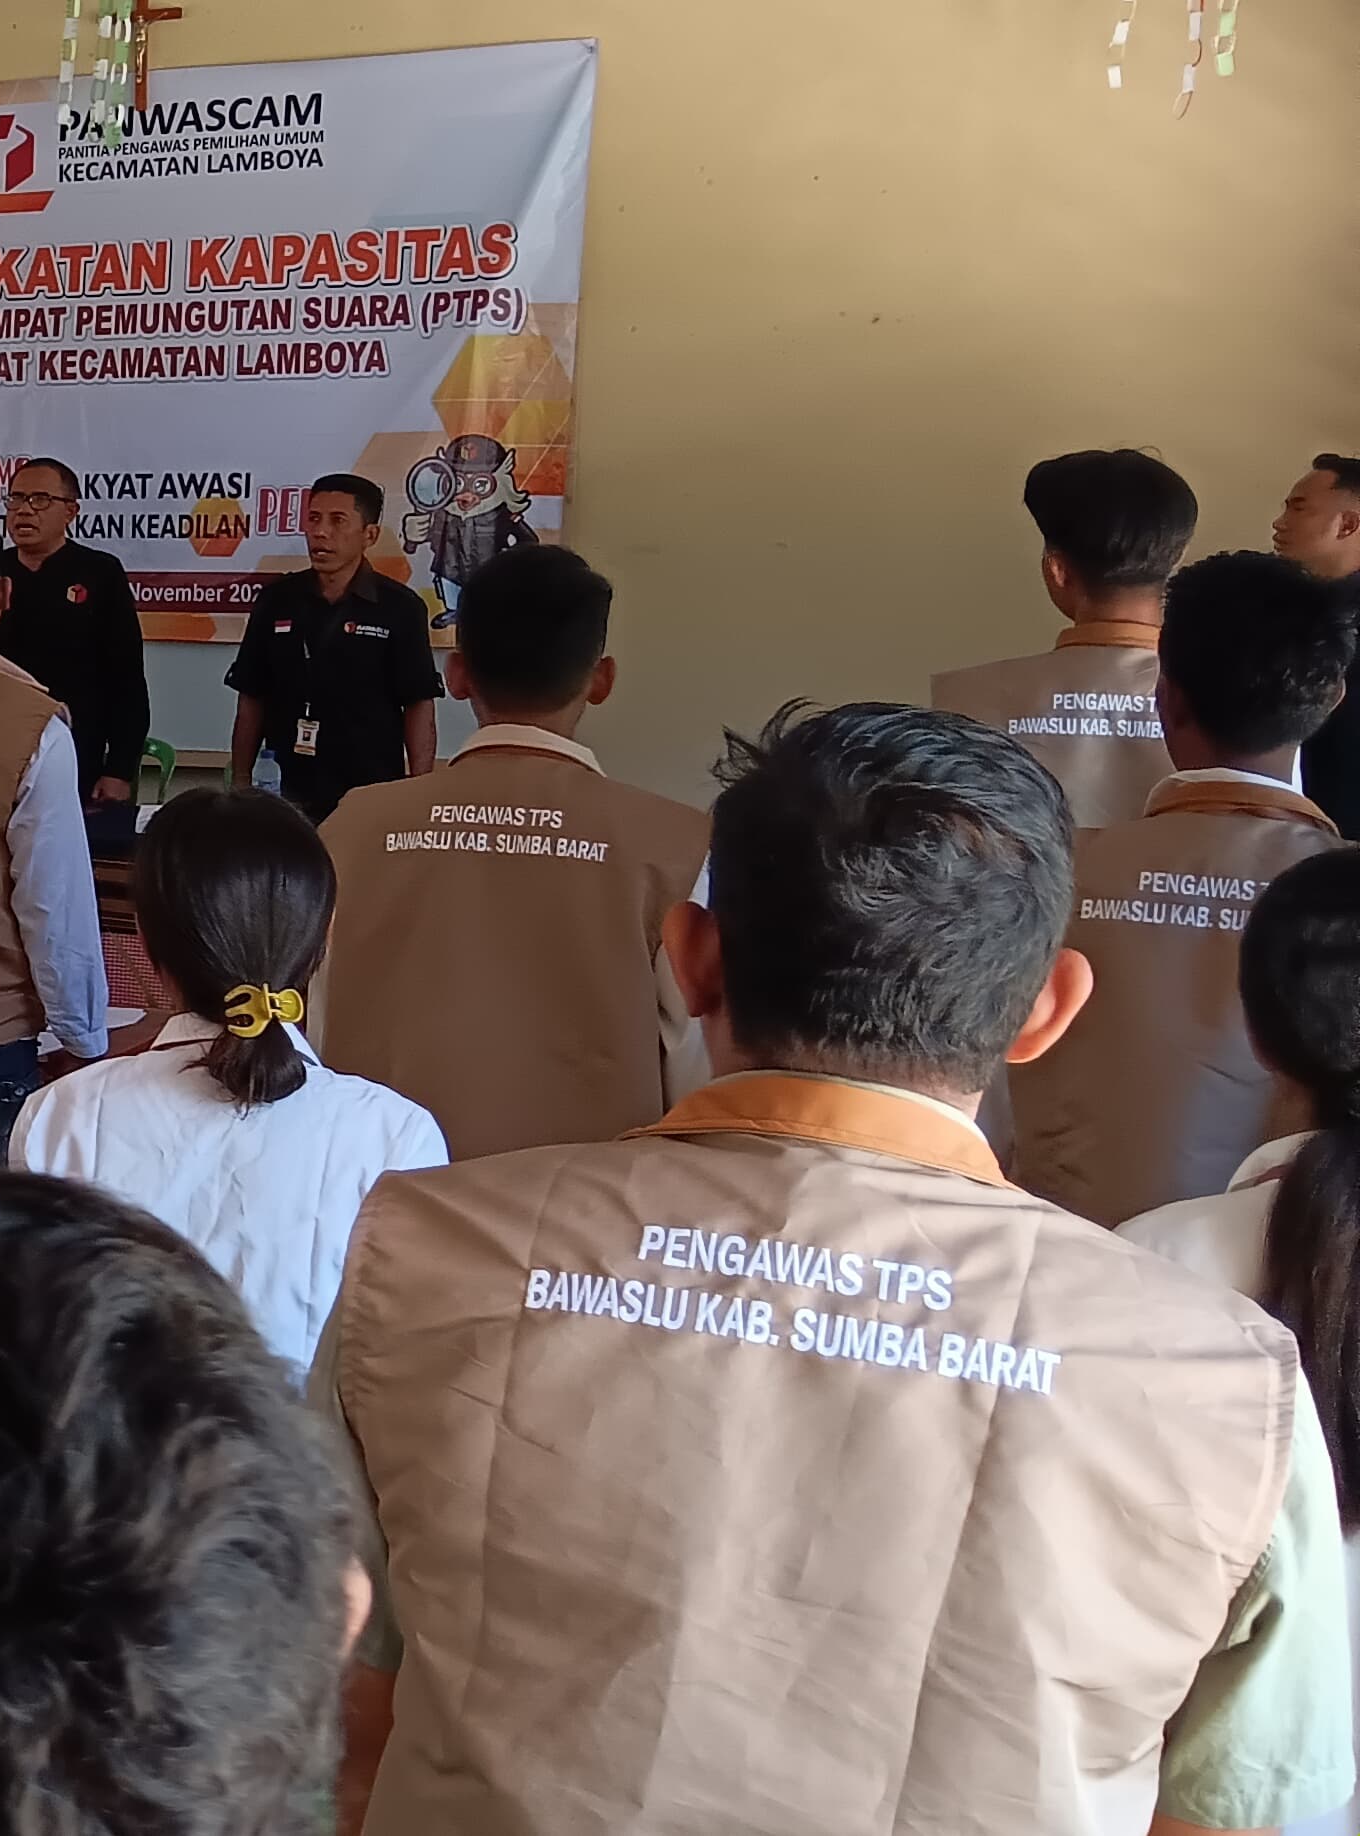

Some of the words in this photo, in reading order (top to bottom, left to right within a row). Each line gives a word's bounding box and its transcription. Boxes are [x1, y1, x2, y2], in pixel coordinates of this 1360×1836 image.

[58, 145, 110, 160] PANITIA
[113, 138, 189, 156] PENGAWAS
[193, 132, 270, 152] PEMILIHAN
[274, 130, 324, 147] UMUM
[58, 155, 199, 183] KECAMATAN
[207, 148, 323, 174] LAMBOYA
[187, 222, 515, 288] KAPASITAS
[75, 296, 293, 337] PEMUNGUTAN
[301, 293, 411, 330] SUARA
[420, 286, 524, 333] (PTPS)
[37, 346, 226, 382] KECAMATAN
[235, 340, 387, 376] LAMBOYA
[158, 471, 252, 500] AWASI
[130, 513, 251, 540] KEADILAN
[129, 582, 224, 603] November
[1053, 693, 1144, 713] PENGAWAS
[1008, 717, 1078, 735] BAWASLU
[1079, 718, 1113, 737] KAB.
[1116, 719, 1165, 739] SUMB
[430, 805, 526, 827] PENGAWAS
[529, 808, 564, 829] TPS
[386, 830, 452, 852] BAWASLU
[454, 831, 491, 852] KAB.
[495, 833, 553, 857] SUMBA
[555, 837, 609, 863] BARAT
[1138, 871, 1256, 901] PENGAWAS
[1080, 898, 1166, 925] BAWASLU
[1169, 903, 1214, 929] KAB.
[638, 1224, 863, 1296] PENGAWAS
[870, 1258, 954, 1312] TPS
[524, 1268, 689, 1331] BAWASLU
[693, 1290, 780, 1348] KAB.
[789, 1307, 928, 1372] SUMBA
[936, 1333, 1062, 1396] BARAT
